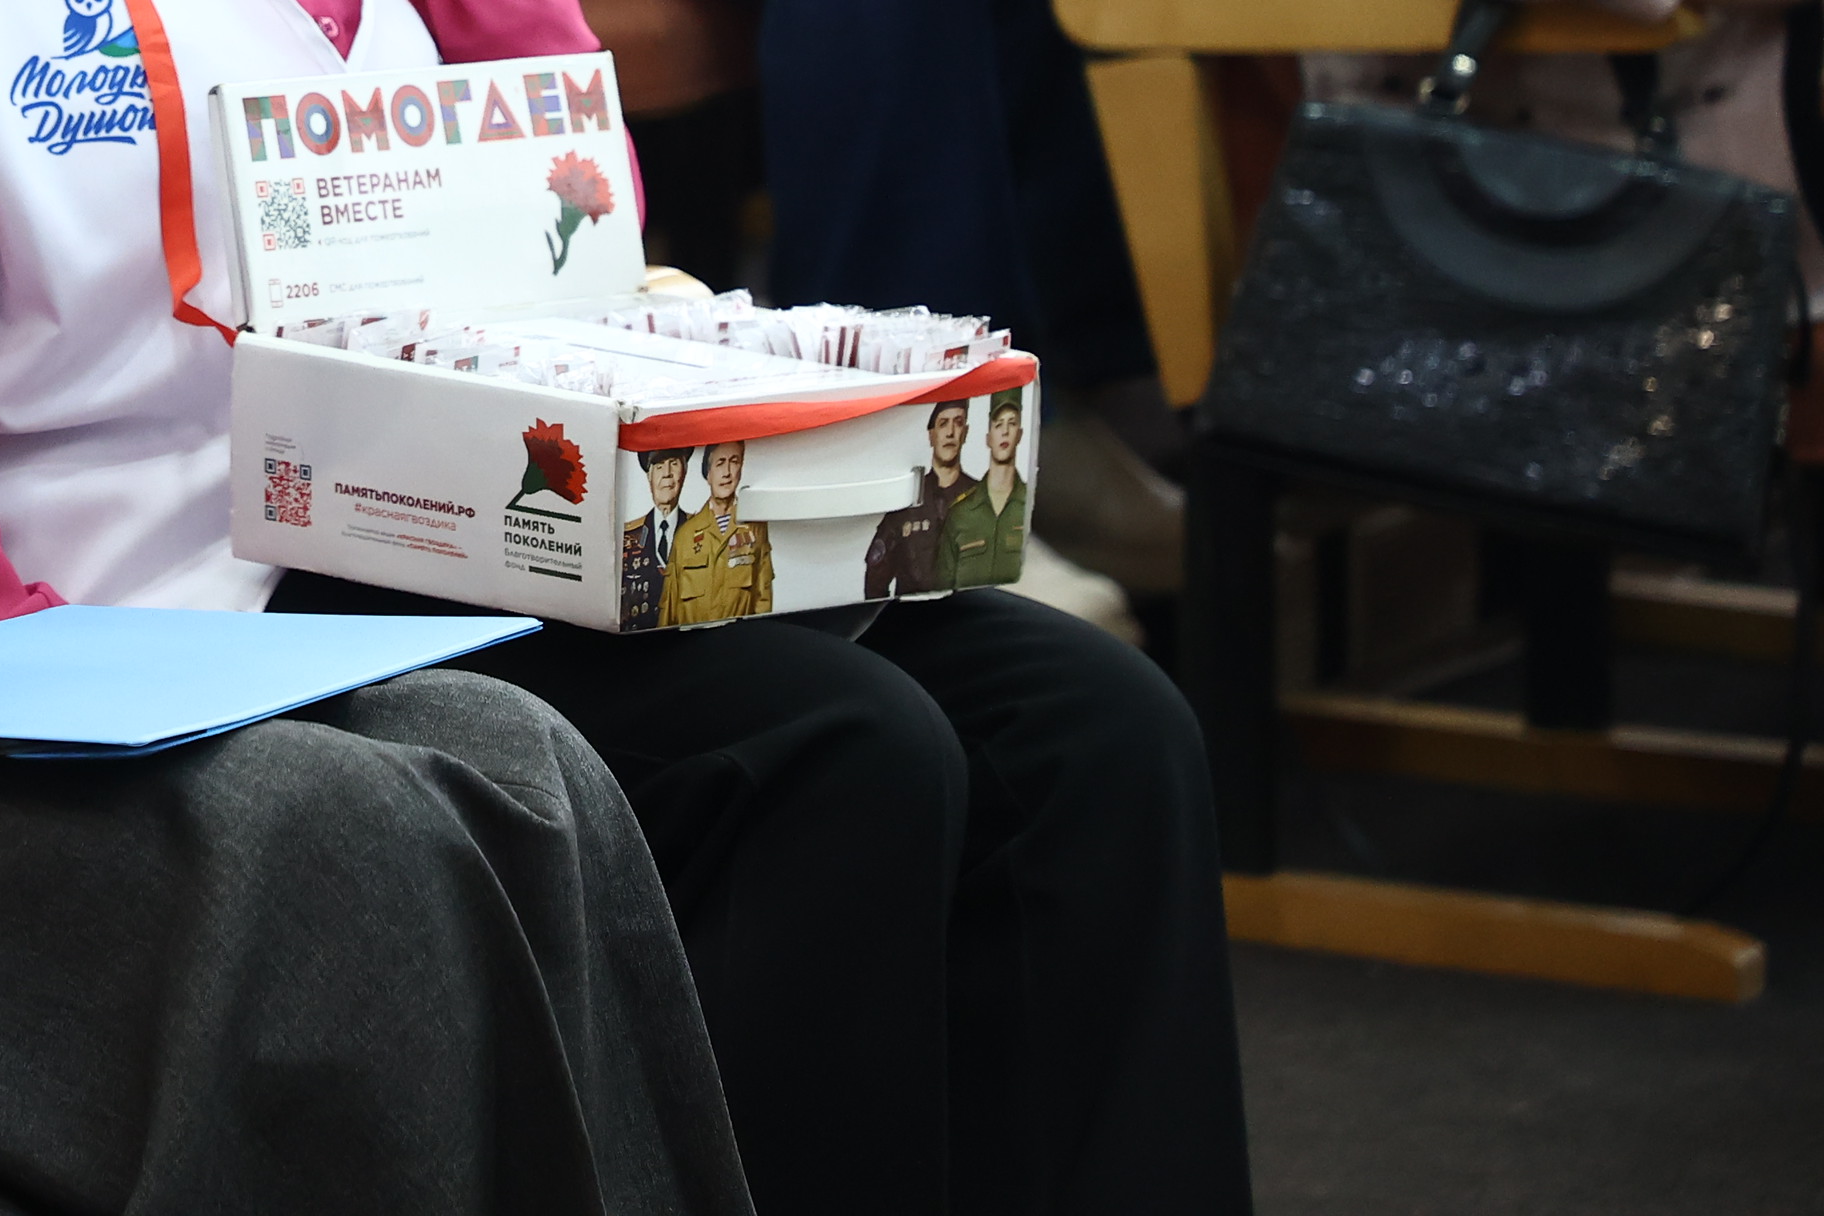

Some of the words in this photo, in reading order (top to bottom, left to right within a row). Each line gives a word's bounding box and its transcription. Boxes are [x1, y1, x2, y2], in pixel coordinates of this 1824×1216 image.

[242, 68, 611, 163] ПОМОГАЕМ
[316, 167, 443, 198] ВЕТЕРАНАМ
[320, 198, 404, 225] ВМЕСТЕ
[286, 282, 319, 299] 2206
[334, 482, 476, 518] ПАМЯТЬПОКОЛЕНИЙ.РФ
[354, 502, 457, 531] #краснаягвоздика
[504, 515, 555, 534] ПАМЯТЬ
[504, 531, 582, 557] ПОКОЛЕНИЙ
